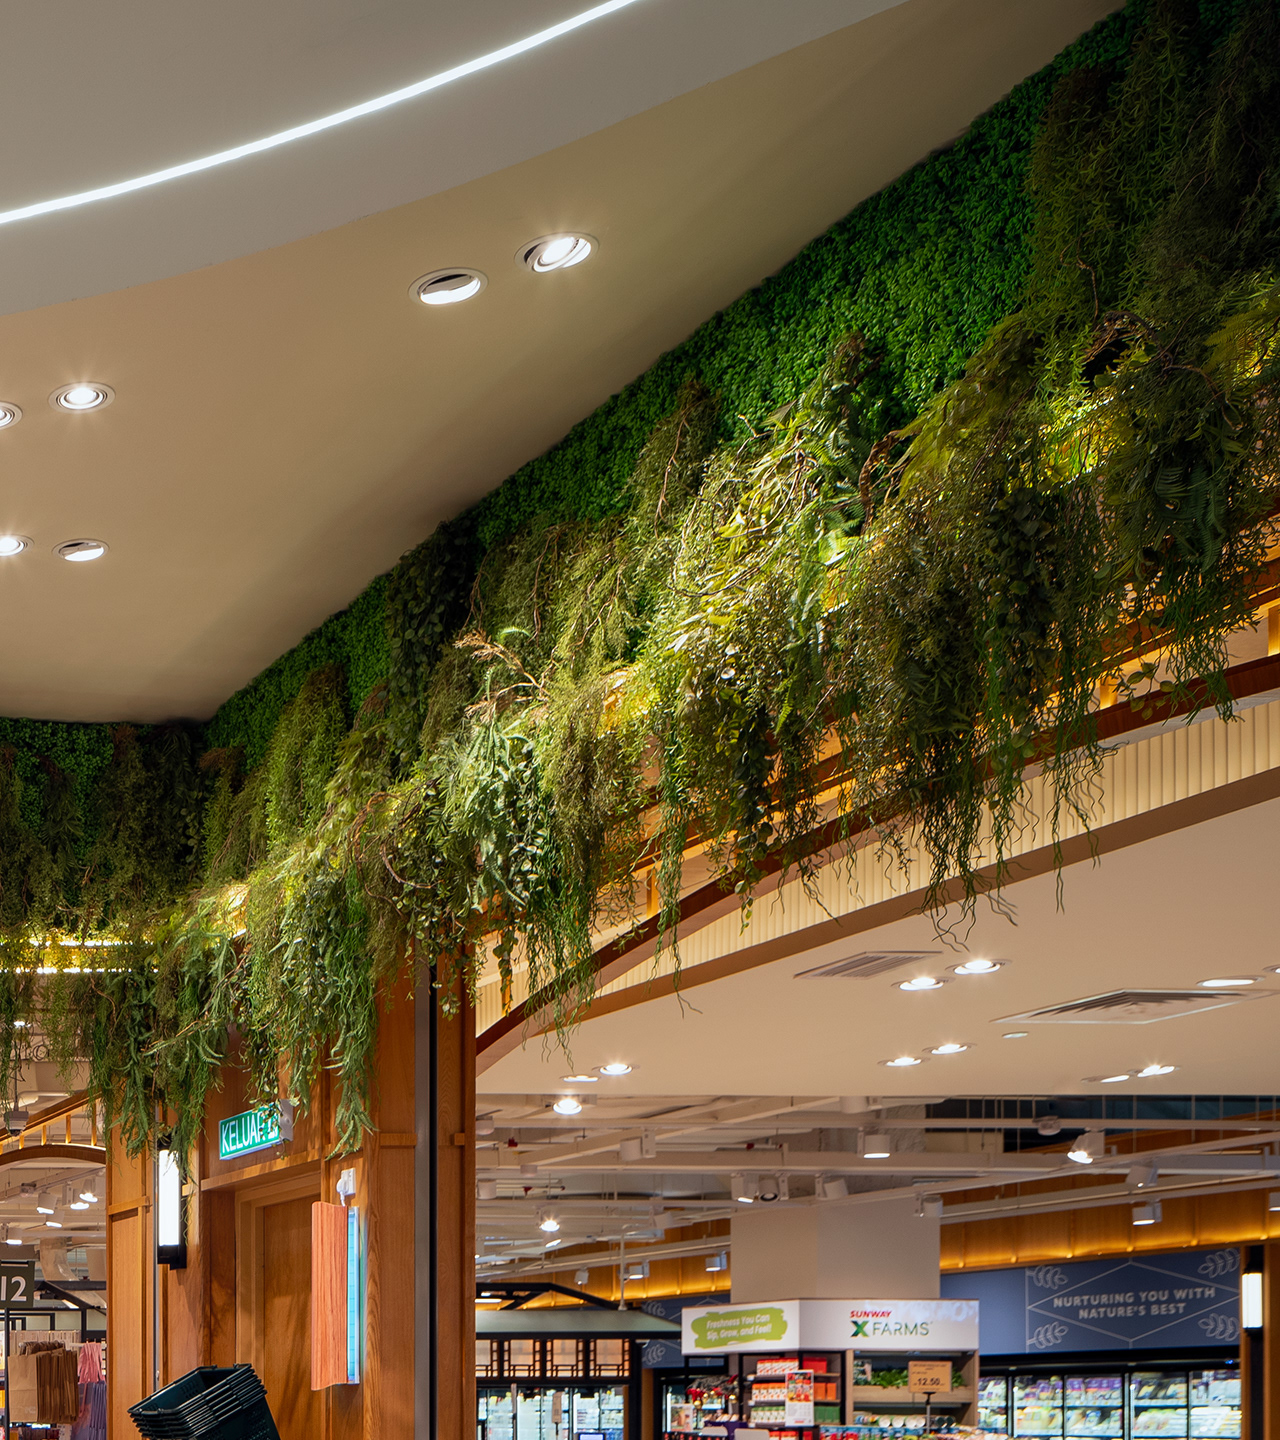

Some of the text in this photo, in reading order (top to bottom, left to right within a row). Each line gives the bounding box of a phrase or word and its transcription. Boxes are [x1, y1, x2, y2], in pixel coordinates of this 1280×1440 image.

[222, 1110, 266, 1153] KELUAR
[0, 1275, 27, 1302] 12
[1053, 1286, 1216, 1308] NURTURING YOU WITH
[850, 1310, 892, 1318] SUNWAY
[1079, 1302, 1186, 1320] NATURE'S BEST
[706, 1313, 770, 1329] Freshness You Can
[872, 1321, 930, 1336] FARMS
[917, 1377, 940, 1386] 12.50
